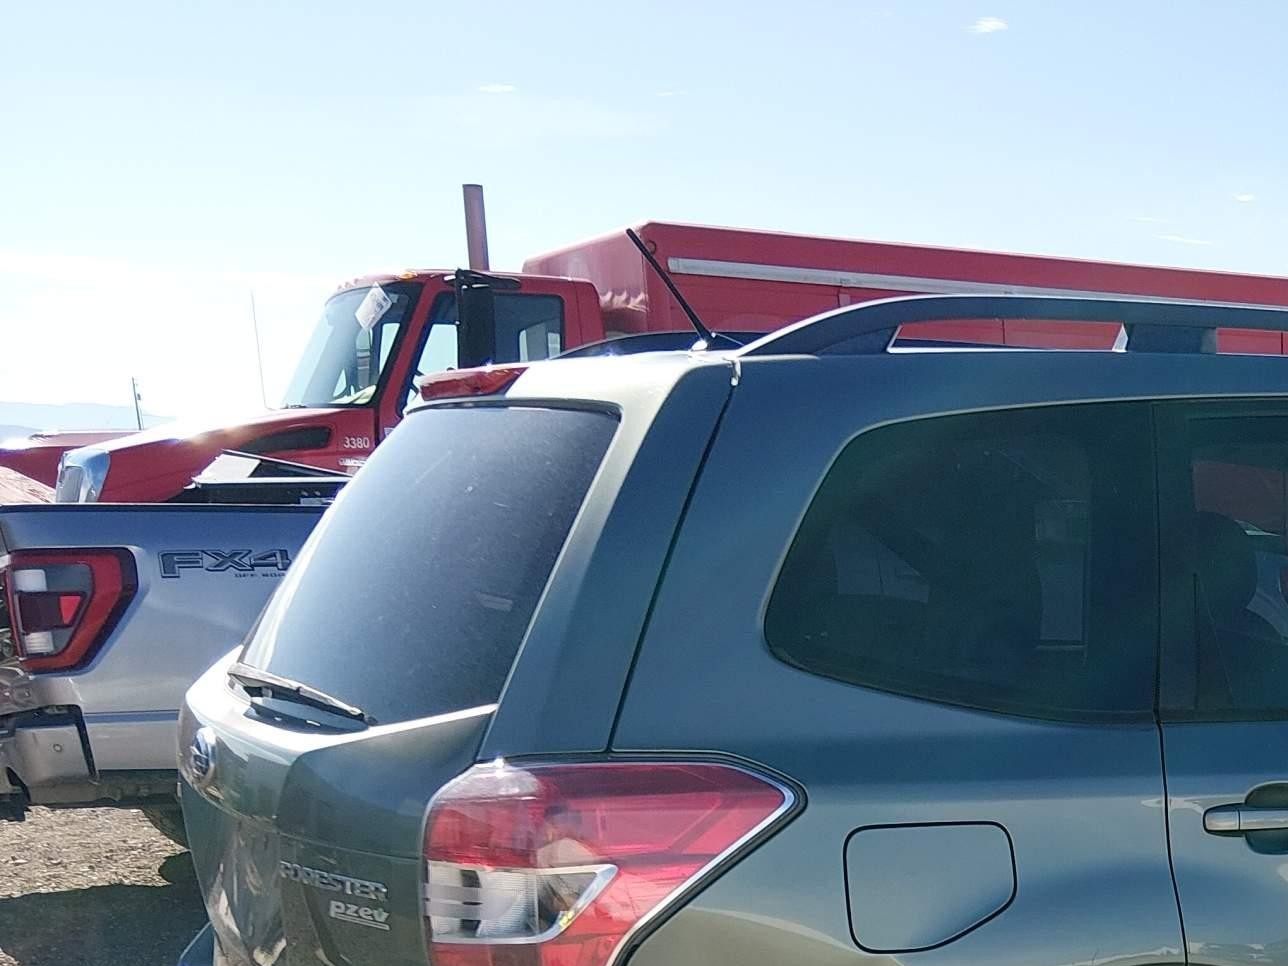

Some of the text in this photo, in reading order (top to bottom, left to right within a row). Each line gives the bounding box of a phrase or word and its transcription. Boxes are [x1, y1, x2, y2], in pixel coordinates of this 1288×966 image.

[343, 436, 370, 449] 3380
[159, 549, 292, 578] FX4
[280, 860, 388, 901] FORESTER
